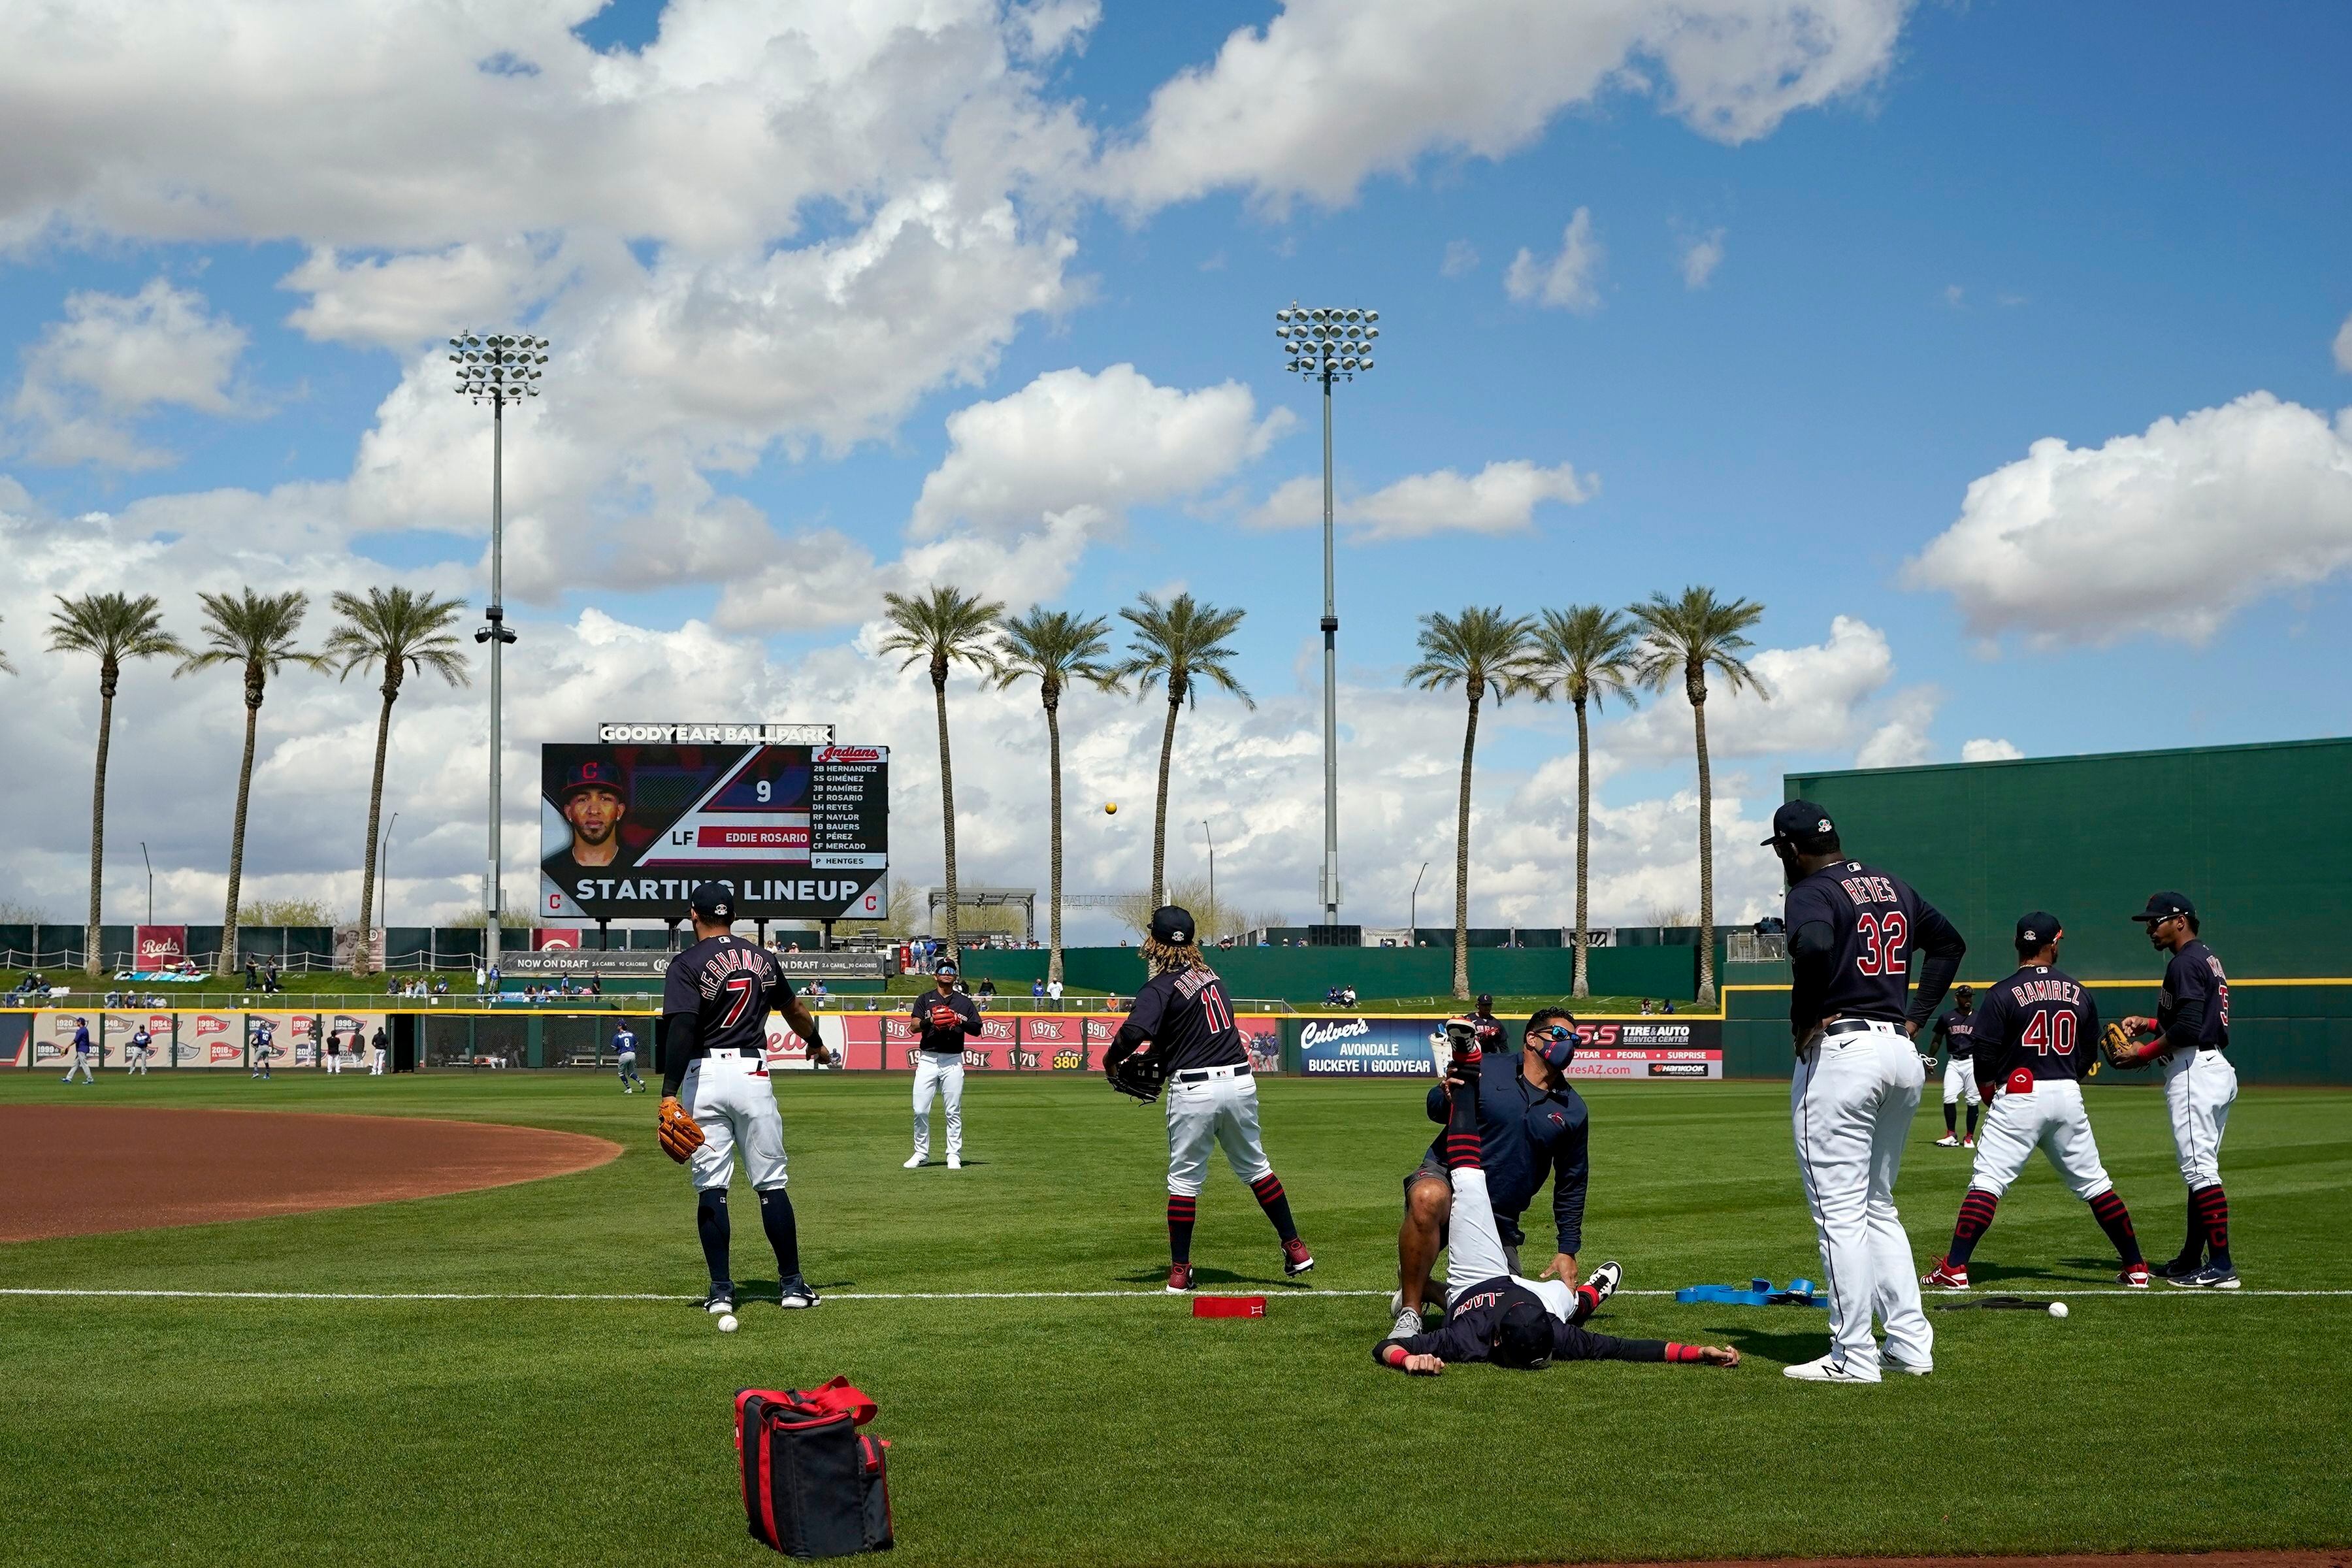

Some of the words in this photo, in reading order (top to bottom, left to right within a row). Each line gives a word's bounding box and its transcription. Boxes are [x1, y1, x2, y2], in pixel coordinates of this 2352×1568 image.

[600, 727, 720, 741] GOODYEAR
[725, 727, 833, 742] BALLPARK
[817, 746, 879, 762] Indians
[582, 762, 597, 779] C
[826, 774, 864, 782] GIMÉNEZ
[756, 780, 771, 802] 9
[672, 831, 693, 845] LF
[726, 833, 757, 842] EDDIE
[760, 833, 808, 843] ROSARIO
[576, 879, 734, 900] STARTI
[744, 880, 858, 900] LINEUP
[1841, 876, 1897, 905] REYES
[550, 894, 561, 909] C
[865, 896, 876, 911] C
[142, 938, 180, 956] Reds
[1857, 911, 1907, 976] 32
[699, 949, 777, 1001] HERNANDEZ
[2012, 980, 2080, 1007] RAMIREZ
[720, 977, 752, 1028] 7
[1201, 985, 1231, 1034] 11
[887, 1021, 905, 1036] 919
[983, 1022, 1006, 1037] 1975
[1032, 1022, 1056, 1037] 1976
[1087, 1021, 1105, 1037] 990
[1301, 1018, 1368, 1049] Culver's
[2022, 1009, 2077, 1056] 40
[624, 1037, 630, 1047] 8
[1340, 1043, 1399, 1056] AVONDALE
[1010, 1052, 1035, 1067] 170
[1309, 1059, 1360, 1072] BUCKEYE
[1372, 1060, 1431, 1073] GOODYEAR
